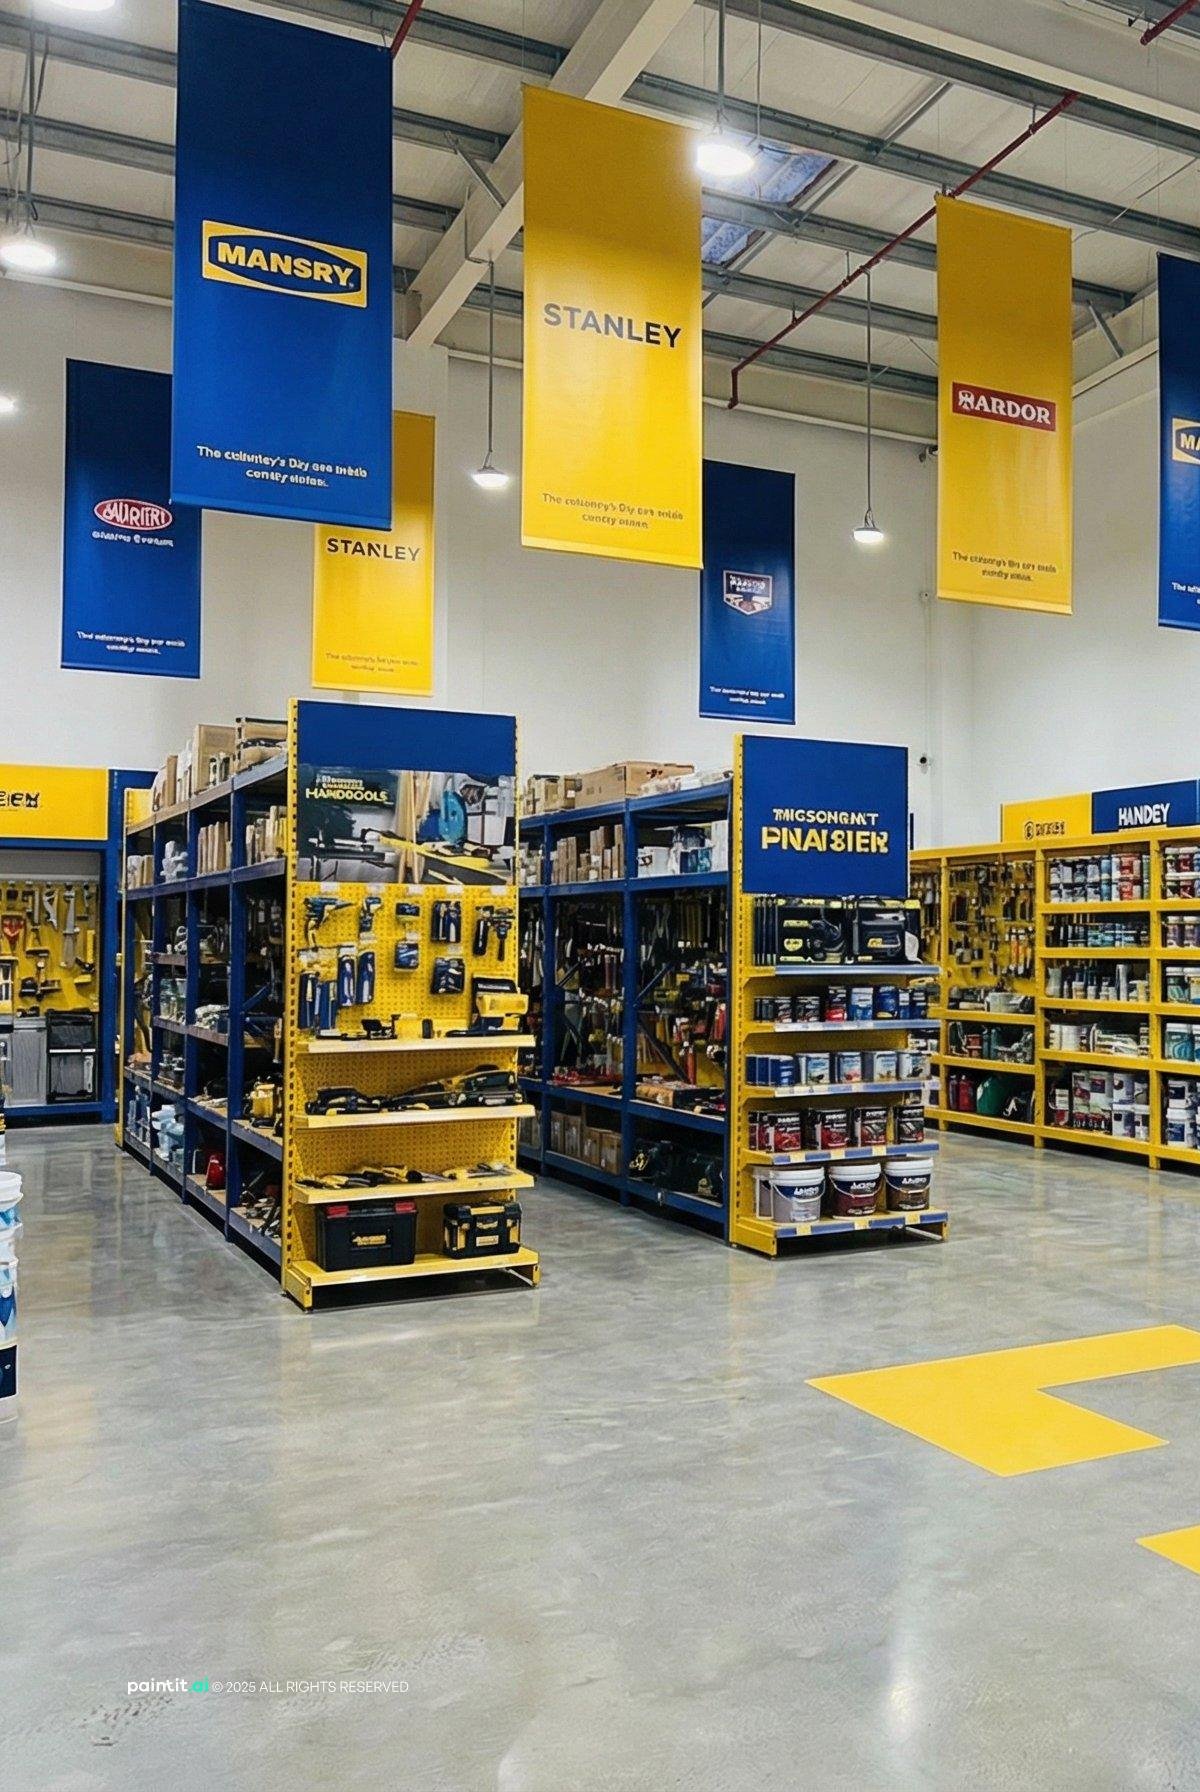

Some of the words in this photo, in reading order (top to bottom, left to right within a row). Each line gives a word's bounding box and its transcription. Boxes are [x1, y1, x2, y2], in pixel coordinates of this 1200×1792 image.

[218, 241, 354, 288] MANSRY
[544, 303, 681, 348] STANLEY
[327, 537, 420, 561] STANLEY
[1118, 802, 1171, 827] HANDEY
